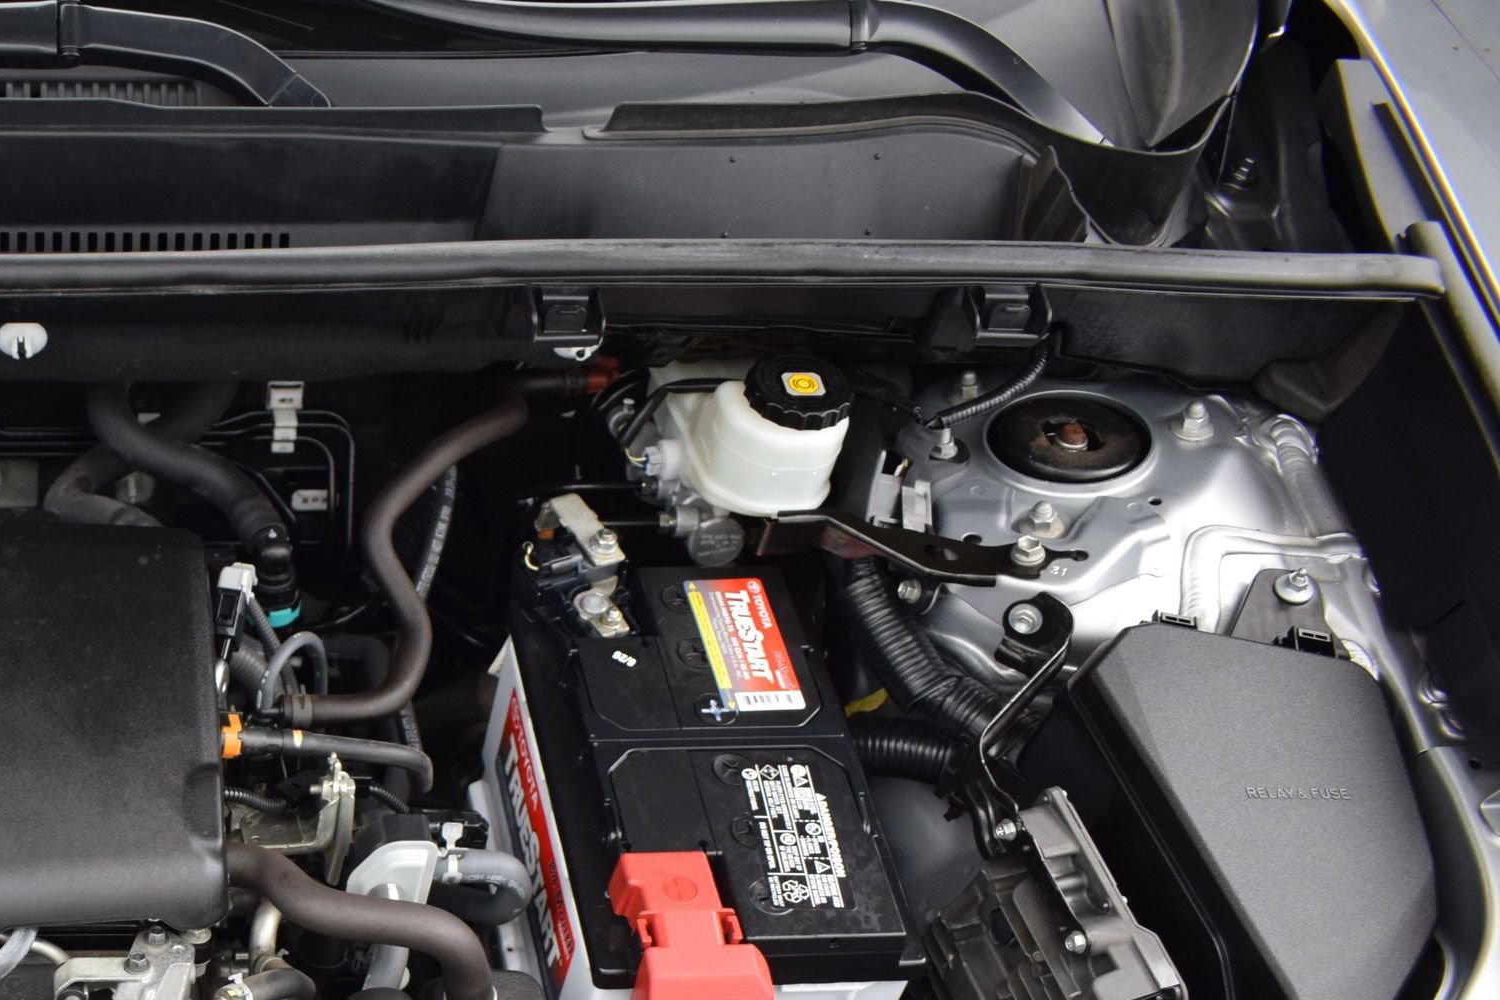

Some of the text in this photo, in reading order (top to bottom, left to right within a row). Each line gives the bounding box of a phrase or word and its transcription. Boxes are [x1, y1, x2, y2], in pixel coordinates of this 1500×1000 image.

[754, 594, 772, 628] TOYOTA
[517, 727, 539, 811] TOYOTA
[1245, 786, 1352, 801] RELAY & FUSE
